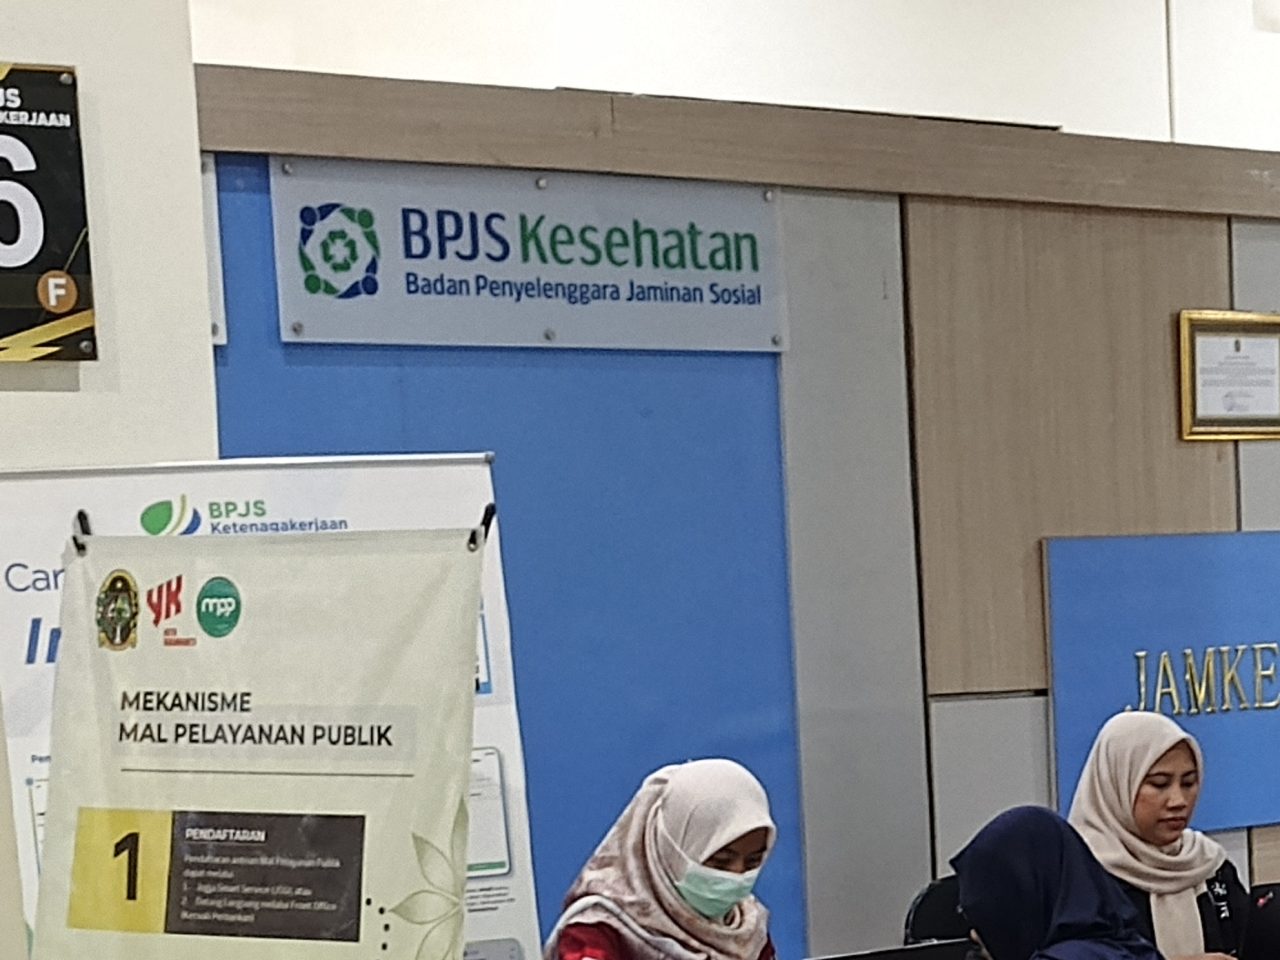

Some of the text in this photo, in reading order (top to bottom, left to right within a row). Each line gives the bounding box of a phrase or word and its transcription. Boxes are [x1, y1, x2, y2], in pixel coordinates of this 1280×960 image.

[402, 208, 760, 271] BPJS Kesehatan
[48, 278, 67, 306] F
[405, 273, 761, 305] Badan Penyelenggara Jaminan Sosial
[208, 500, 266, 519] BPJS
[210, 517, 348, 534] Ketenagakerjaan
[120, 691, 252, 713] MEKANISME
[118, 723, 393, 747] MAL PELAYANAN PUBLIK
[185, 828, 266, 843] PENDAFTARAN
[114, 832, 139, 900] 1
